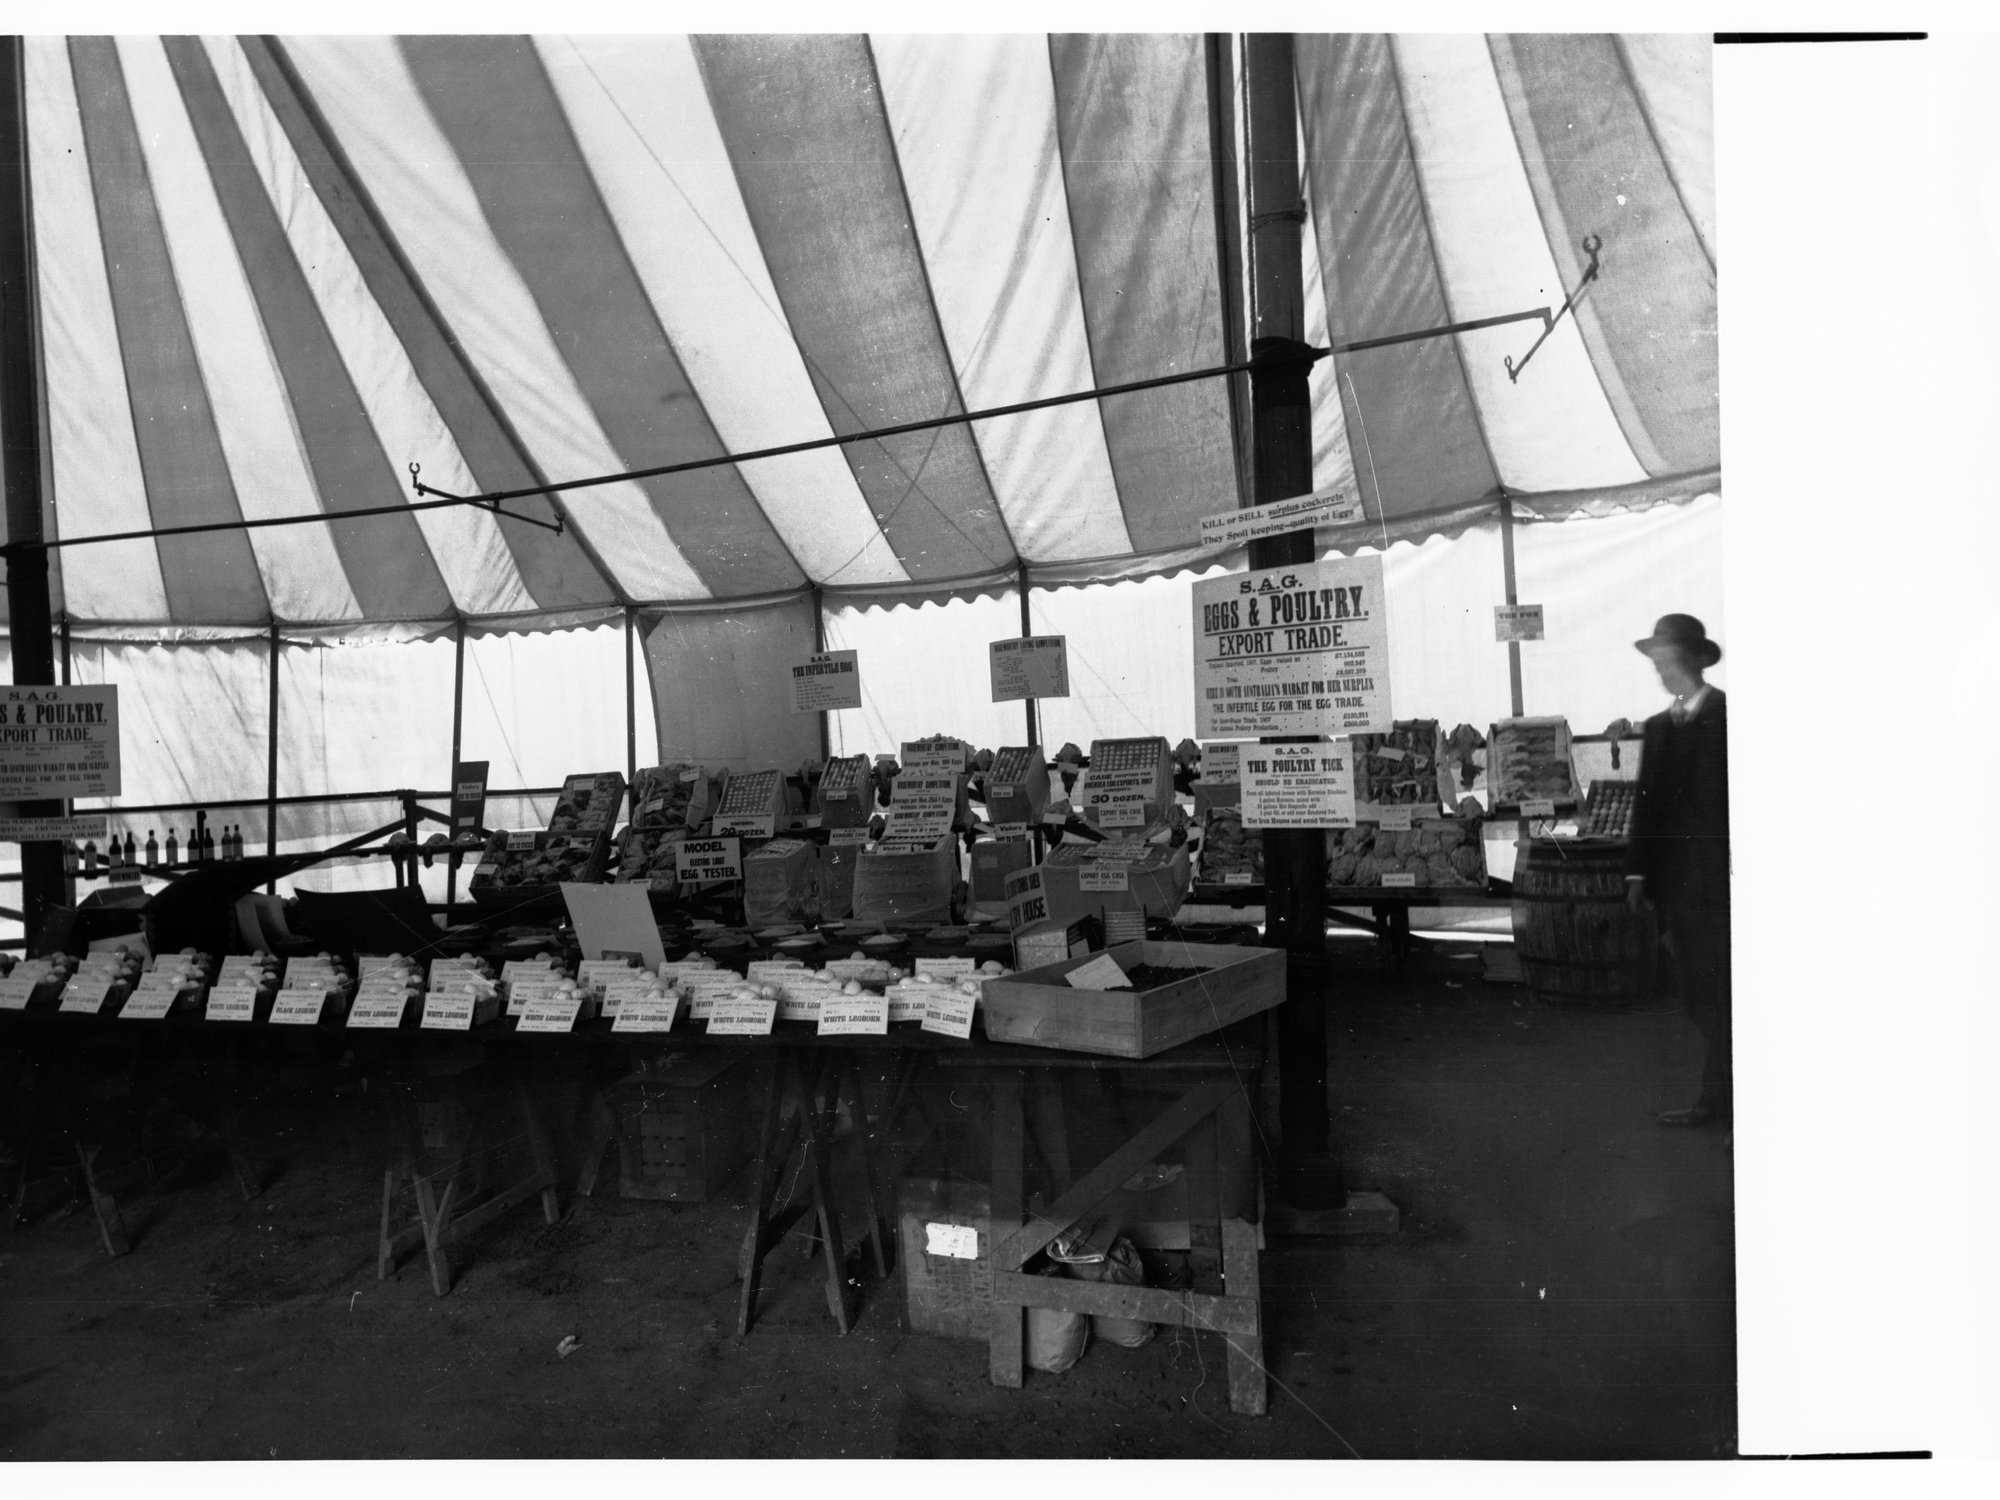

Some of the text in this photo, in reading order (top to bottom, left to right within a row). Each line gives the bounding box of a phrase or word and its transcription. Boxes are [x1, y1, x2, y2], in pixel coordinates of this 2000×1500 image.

[1202, 518, 1225, 530] KILL
[1238, 510, 1264, 523] SELL
[1268, 500, 1300, 516] surplus
[1301, 493, 1345, 509] cockerels
[1203, 534, 1223, 545] They
[1227, 530, 1249, 541] Spoil
[1321, 513, 1330, 521] of
[1240, 574, 1303, 594] S.A.G.
[1204, 585, 1369, 633] EGGS & POULTRY.
[1219, 624, 1348, 656] EXPORT TRADE.
[792, 661, 852, 678] THE INFERTILE EGG
[1282, 681, 1310, 696] MARKET
[1312, 681, 1325, 694] FOR
[1327, 679, 1342, 693] HER
[9, 691, 63, 702] S.A.G.
[1213, 703, 1225, 713] THE
[1226, 701, 1259, 713] INFERTILE
[1261, 701, 1276, 711] EGG
[1280, 700, 1294, 711] FOR
[1297, 699, 1313, 711] THE
[1316, 698, 1332, 709] EGG
[16, 703, 108, 725] & POULTRY.
[1275, 747, 1313, 755] S.A.G.
[1248, 760, 1268, 773] THE
[1272, 759, 1316, 773] POULTRY
[1321, 758, 1344, 771] TICK
[1091, 794, 1109, 804] 30
[690, 857, 725, 867] ELECTRIC LIGHT
[681, 869, 699, 880] EGG
[927, 1011, 942, 1019] WHITE
